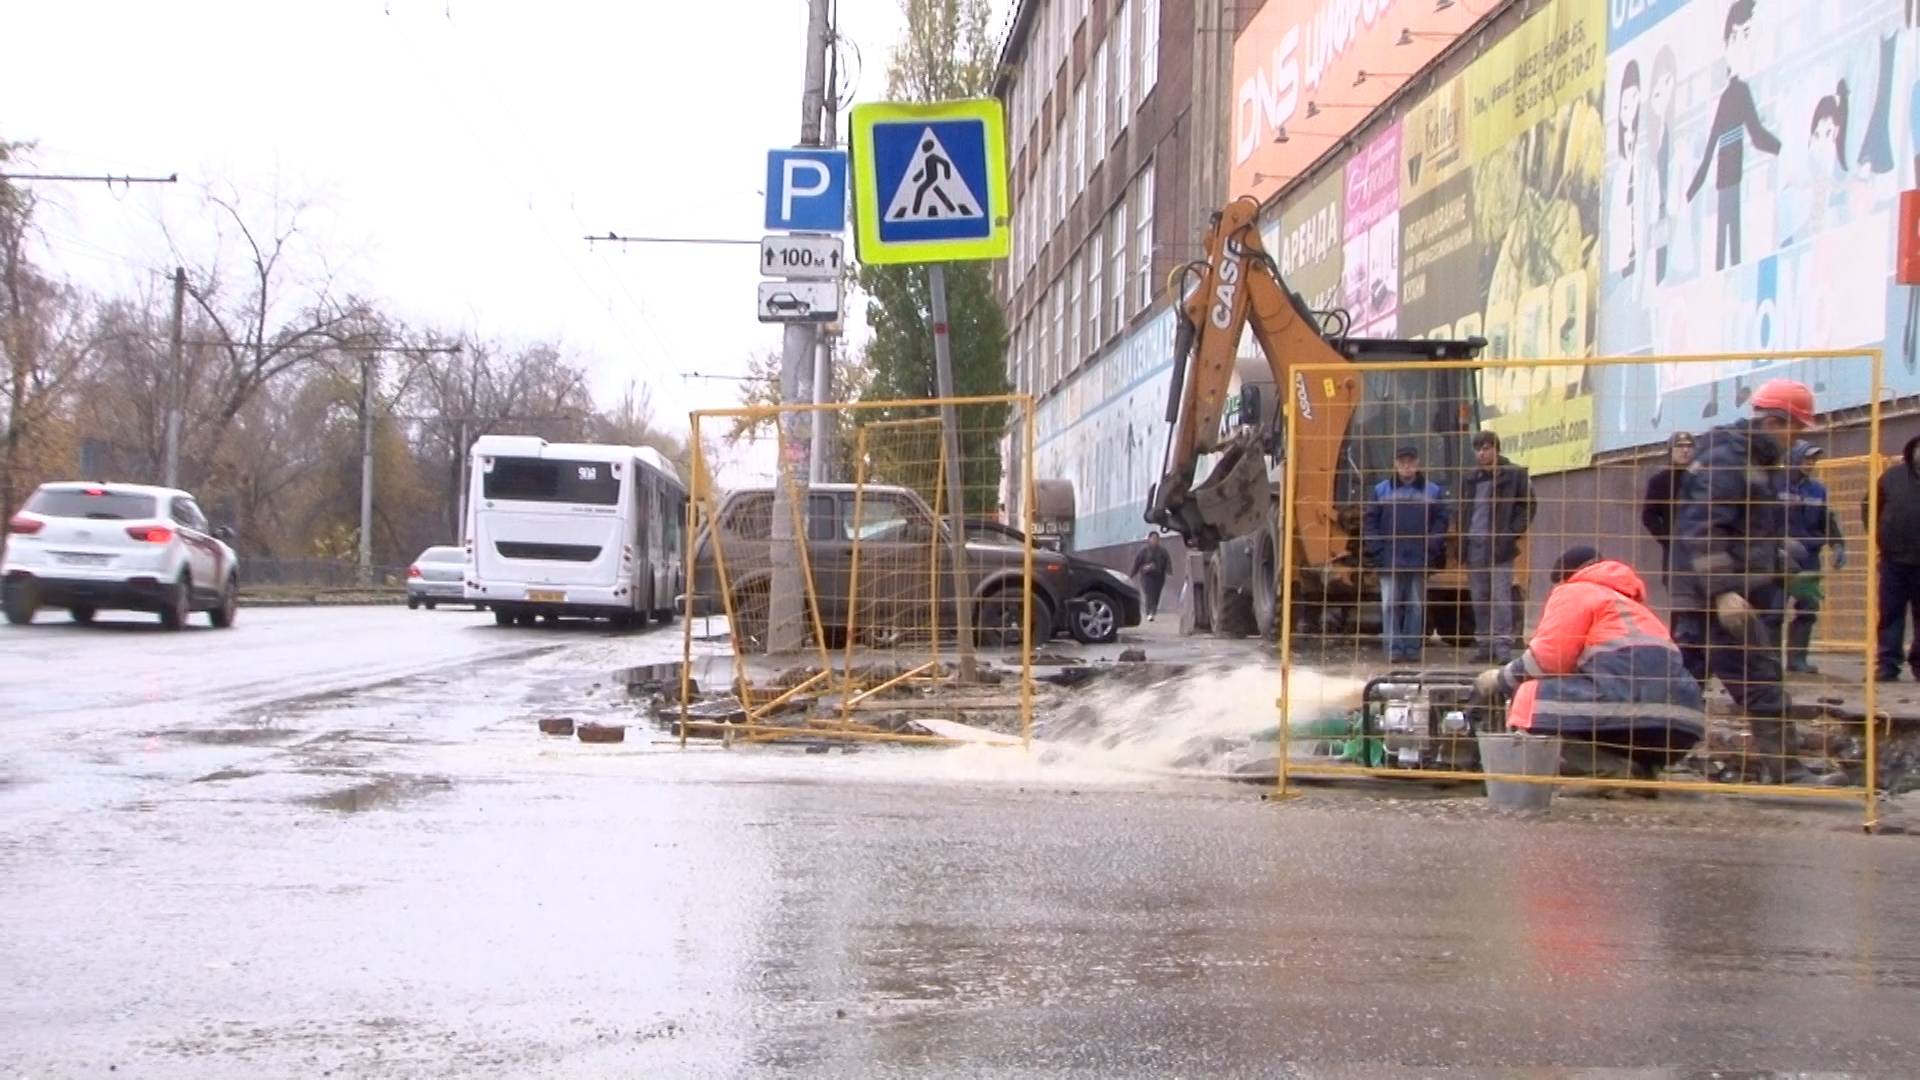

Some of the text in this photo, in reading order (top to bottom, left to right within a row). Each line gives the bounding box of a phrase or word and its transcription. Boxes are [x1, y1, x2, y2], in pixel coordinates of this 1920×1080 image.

[1236, 23, 1300, 166] DNS
[781, 158, 831, 222] P
[1281, 201, 1338, 277] АРЕНДА
